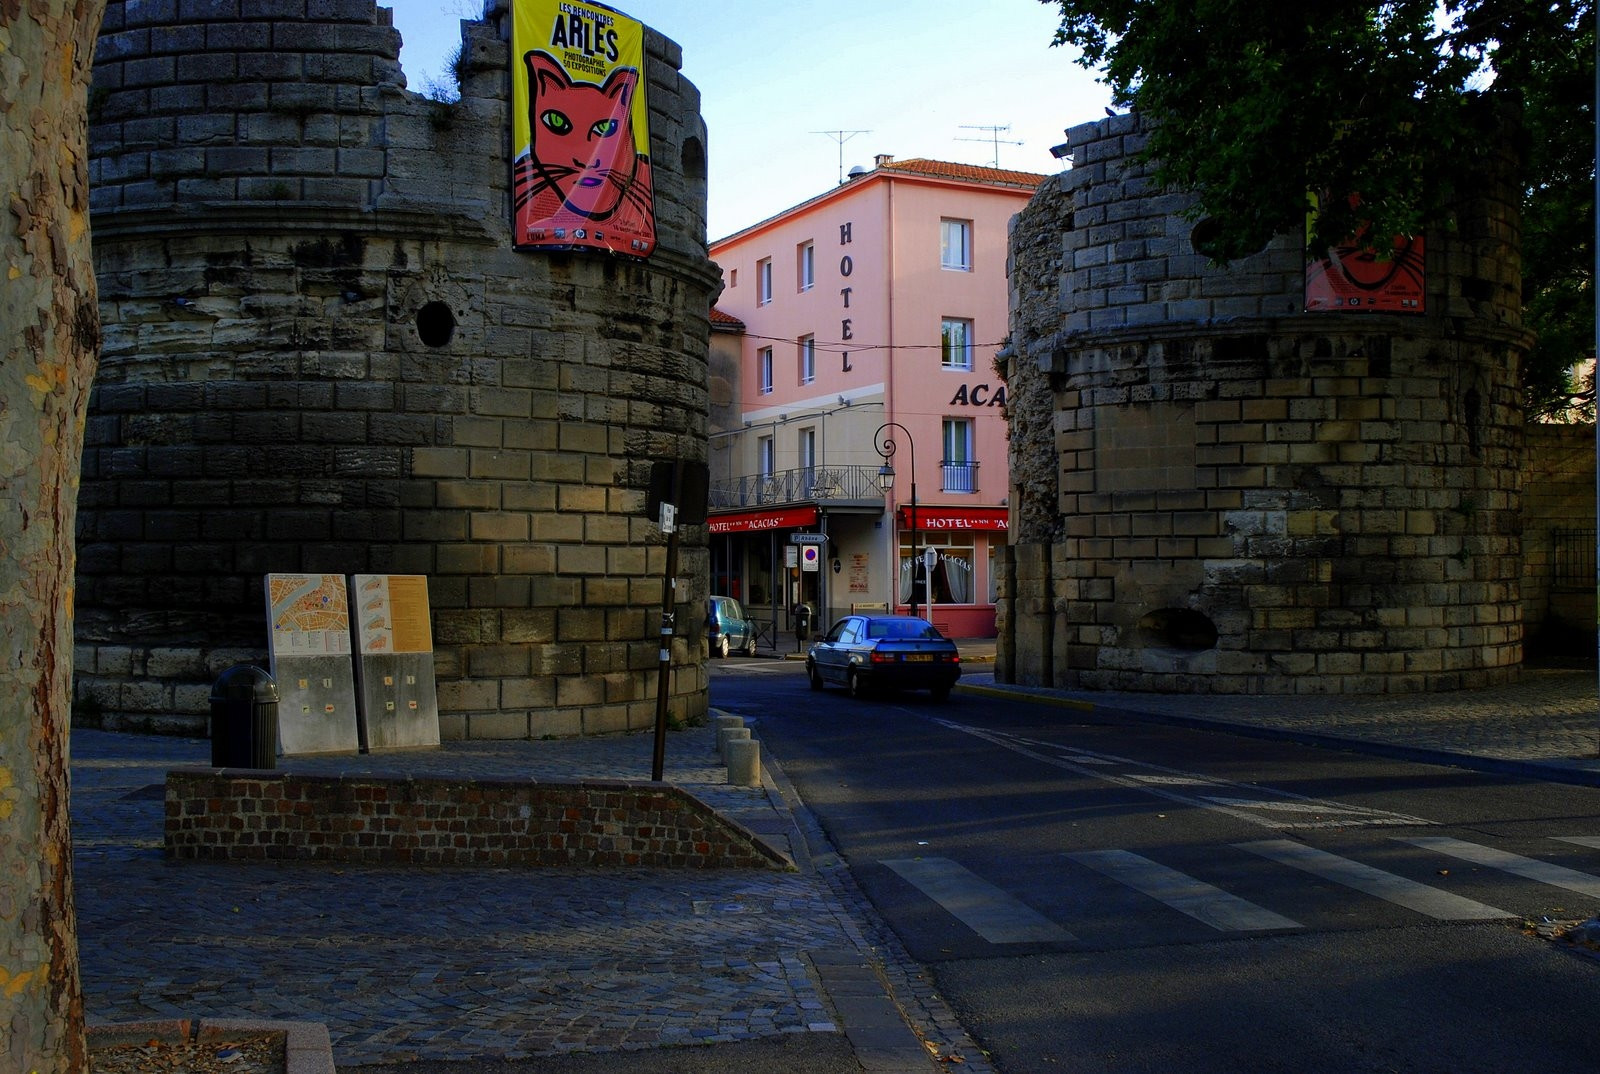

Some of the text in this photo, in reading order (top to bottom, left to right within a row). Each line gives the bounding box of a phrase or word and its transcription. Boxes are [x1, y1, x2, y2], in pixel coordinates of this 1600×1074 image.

[559, 2, 614, 27] LES RENCONTRES
[551, 14, 619, 63] ARLES
[563, 59, 606, 77] 50 EXPOSITIONS
[564, 51, 605, 68] PHOTOGRAPHIE
[839, 222, 854, 373] HOTEL
[709, 522, 731, 532] HOTEL
[926, 518, 972, 528] HOTEL
[938, 553, 972, 571] ACACIAS
